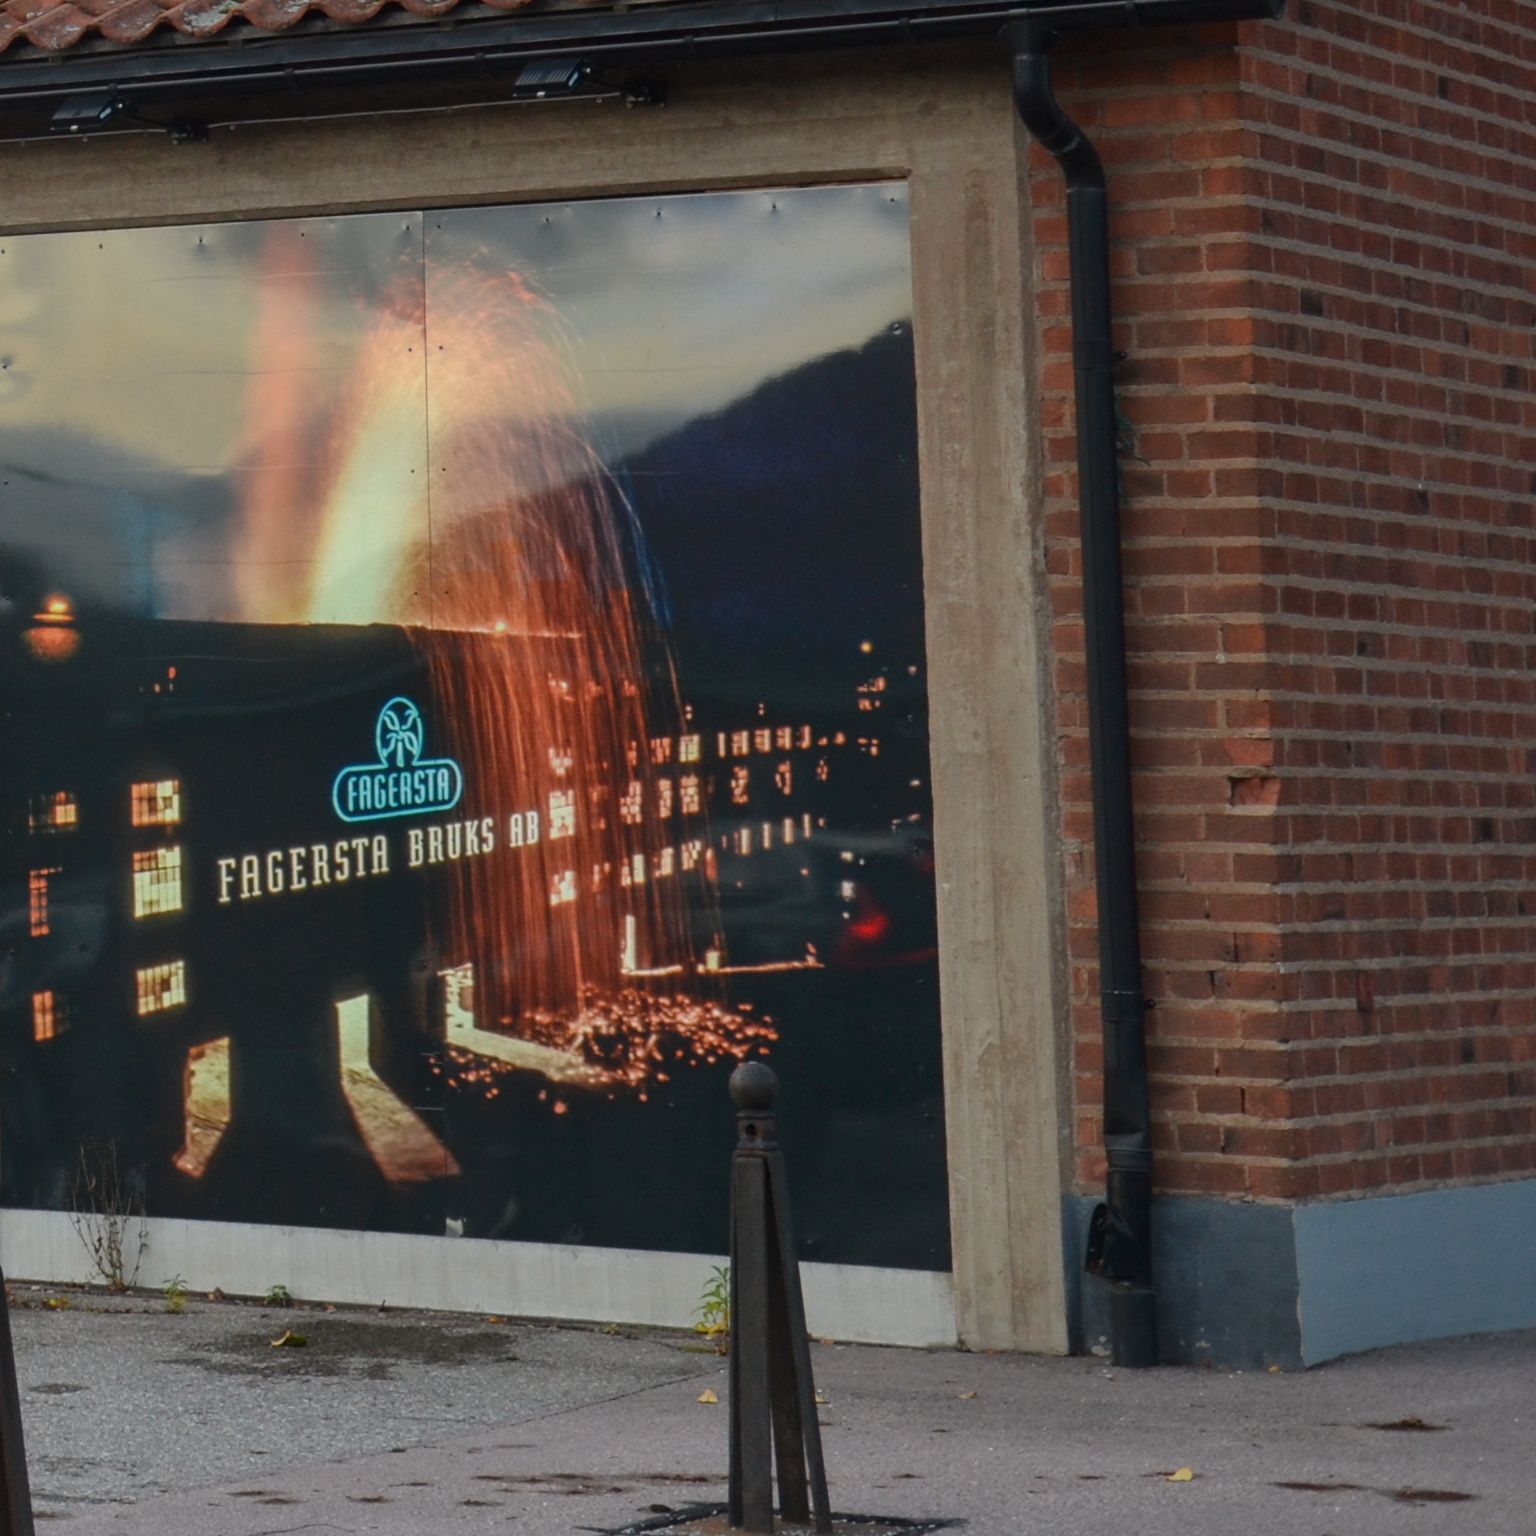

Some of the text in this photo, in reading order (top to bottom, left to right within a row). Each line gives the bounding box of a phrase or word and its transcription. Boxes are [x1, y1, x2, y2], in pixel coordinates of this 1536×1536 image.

[347, 768, 450, 812] FAGERSTA
[218, 811, 539, 903] FAGERSTA BRUKS AB
